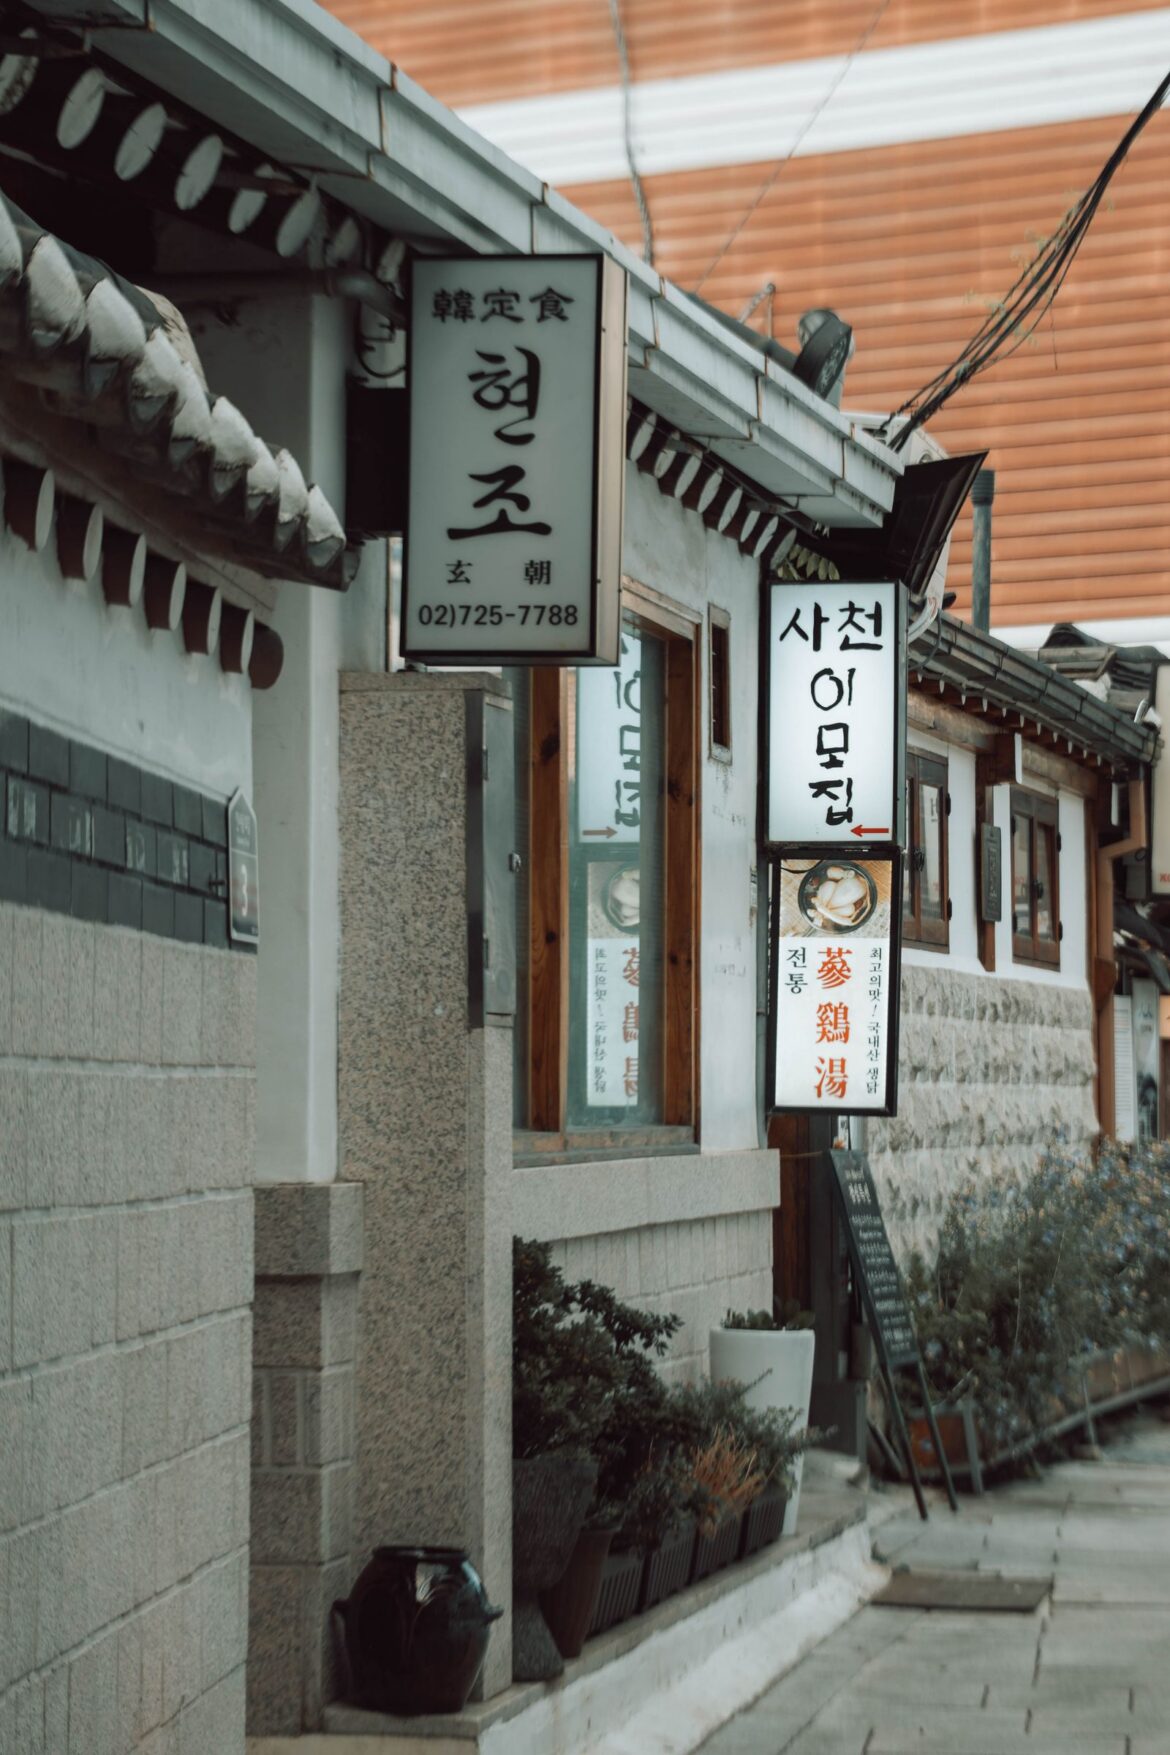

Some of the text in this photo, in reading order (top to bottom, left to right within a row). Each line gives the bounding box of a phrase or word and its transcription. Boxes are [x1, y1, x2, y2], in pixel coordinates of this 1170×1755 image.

[431, 286, 575, 324] 韓定食
[446, 345, 552, 541] 현조
[418, 604, 578, 630] 02)725-7788
[784, 946, 809, 995] 전통
